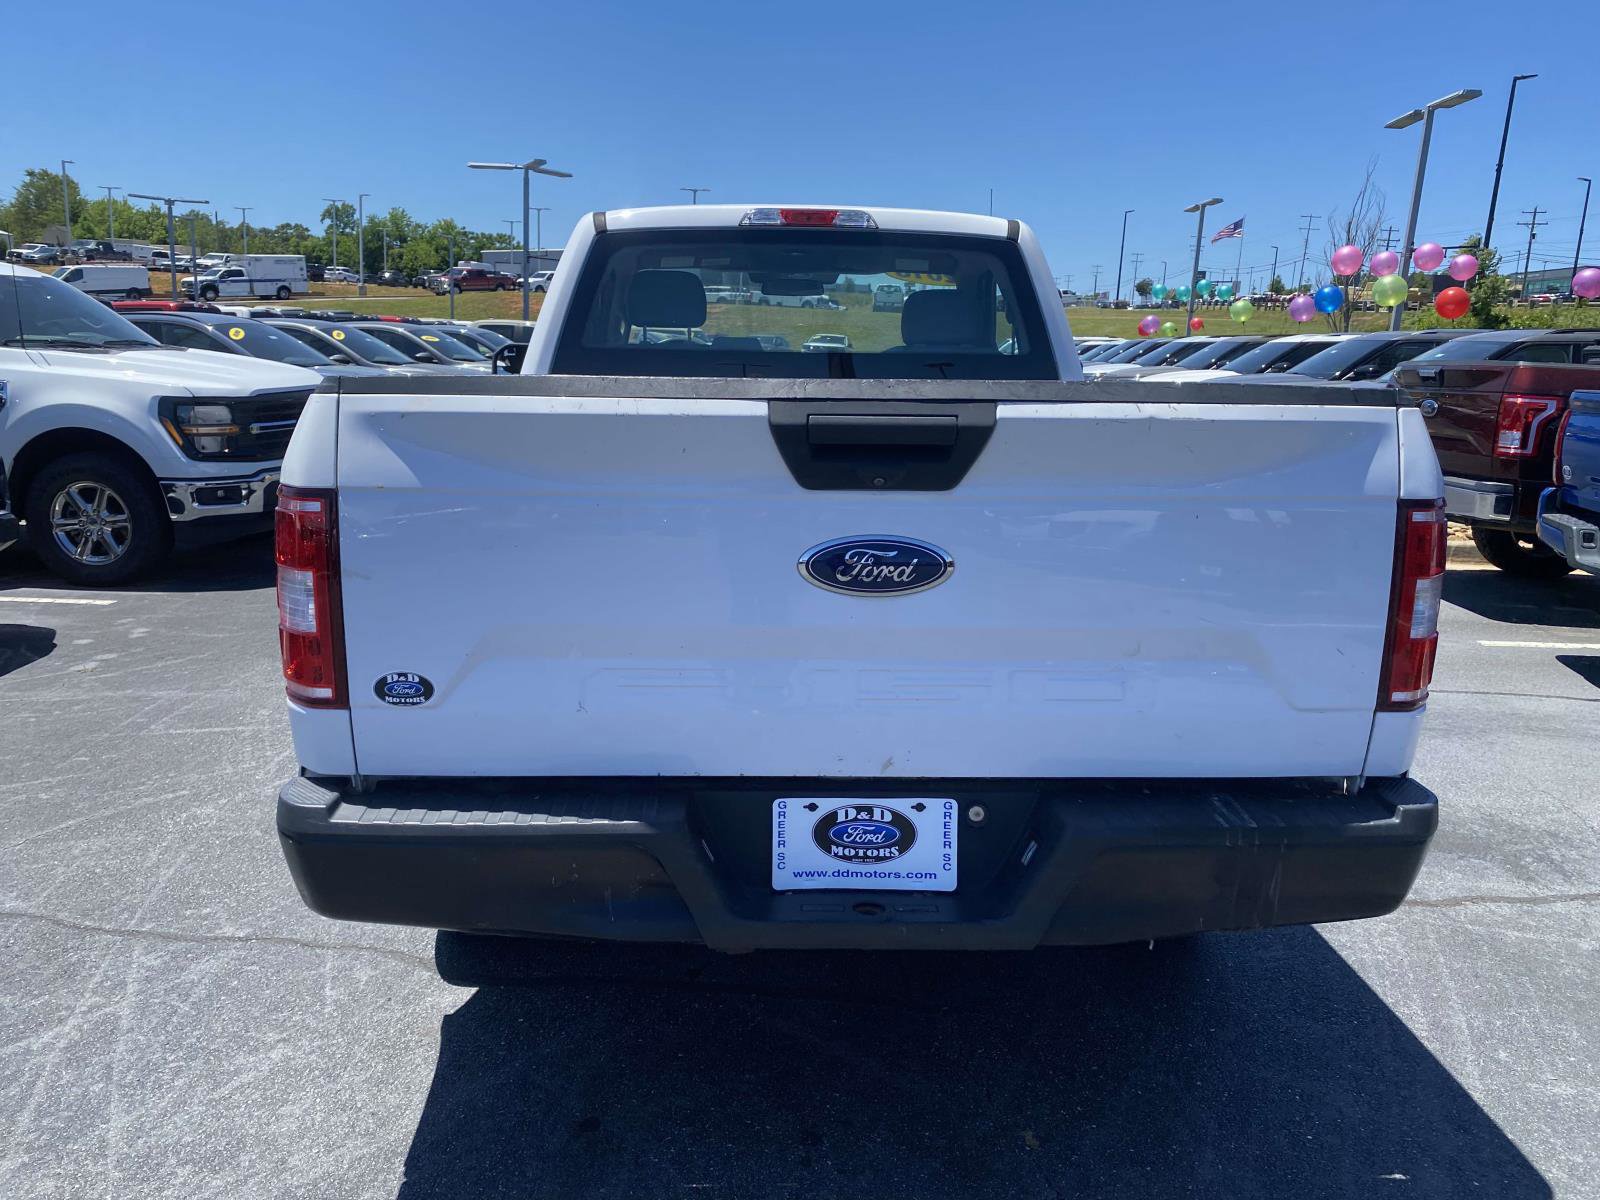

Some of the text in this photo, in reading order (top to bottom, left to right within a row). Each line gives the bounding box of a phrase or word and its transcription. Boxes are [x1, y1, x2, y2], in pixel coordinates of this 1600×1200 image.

[836, 548, 919, 582] Ford
[386, 673, 420, 683] D&D
[392, 684, 416, 694] Ford
[835, 807, 893, 823] D&D
[777, 801, 787, 870] GREER SC
[843, 825, 886, 843] Ford
[942, 801, 953, 871] GREER SC
[830, 845, 900, 857] MOTORS
[792, 869, 938, 880] www.ddmotors.com
